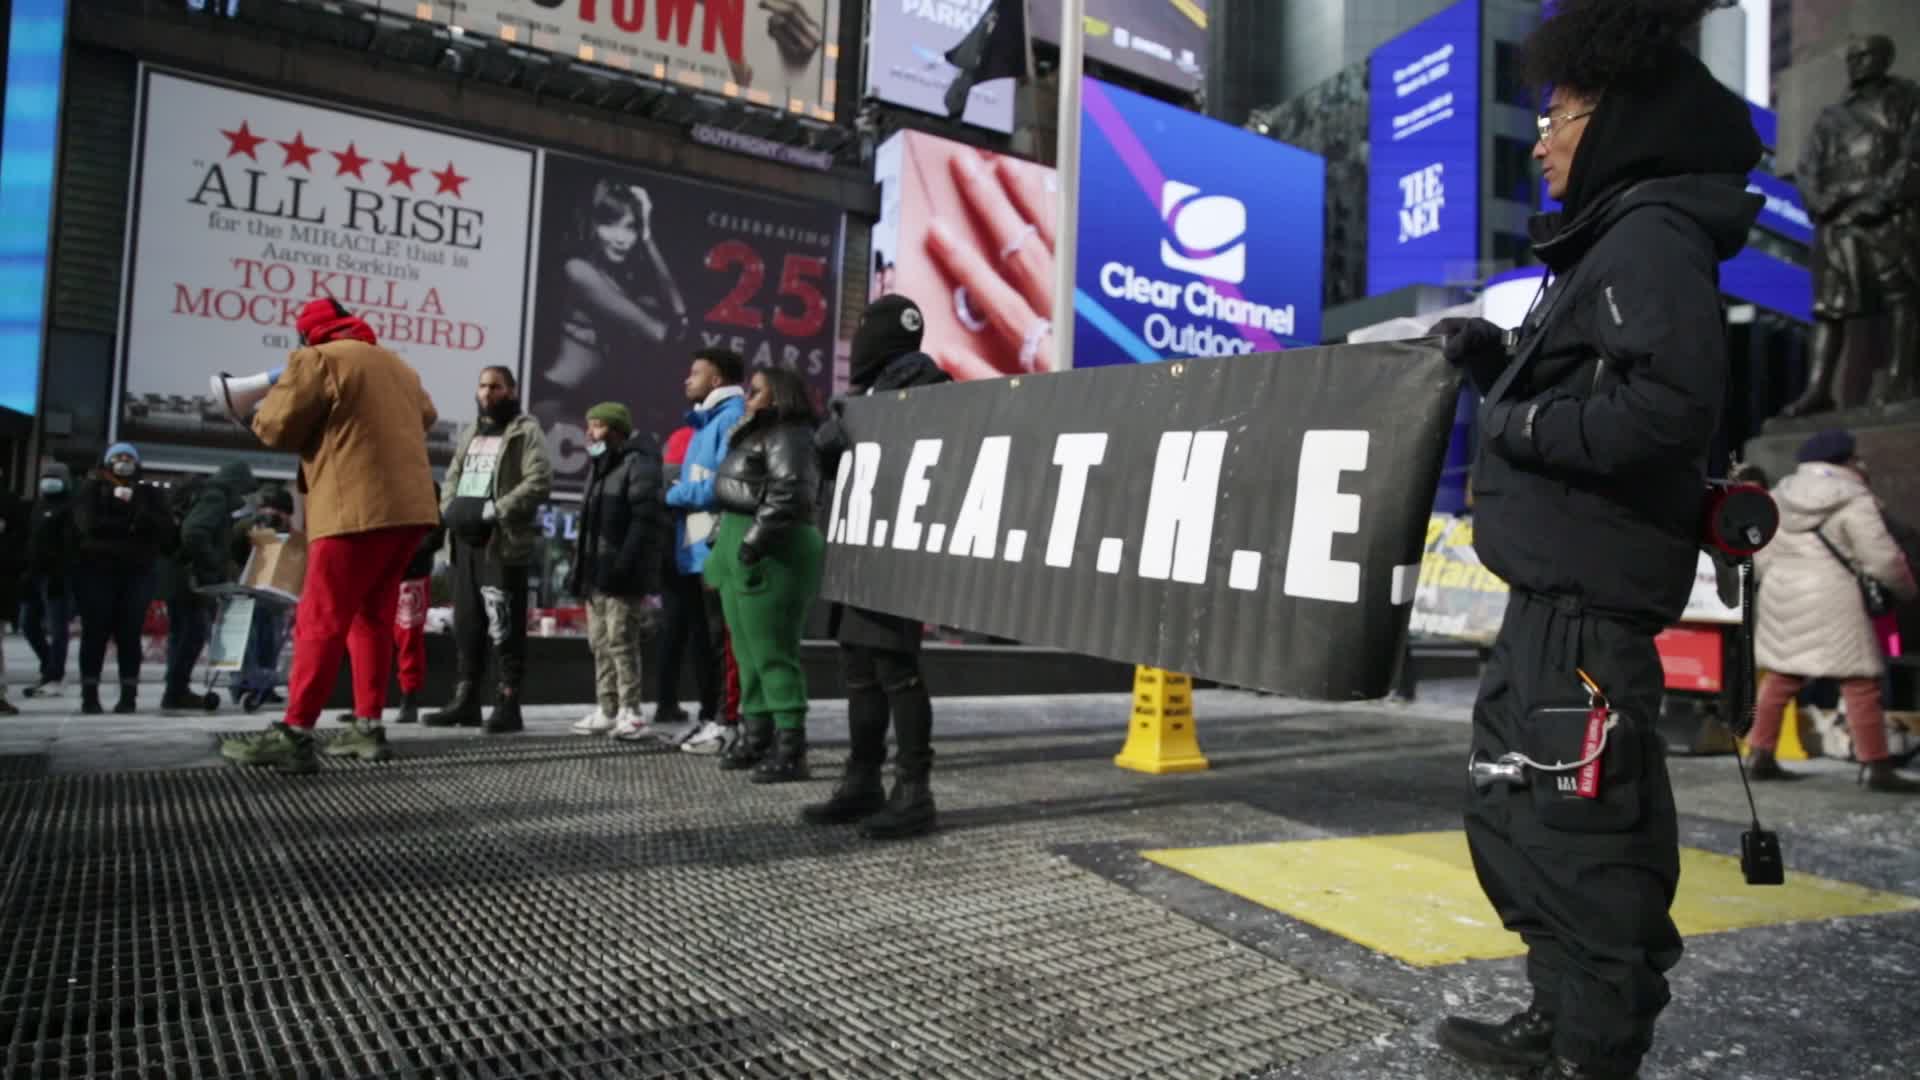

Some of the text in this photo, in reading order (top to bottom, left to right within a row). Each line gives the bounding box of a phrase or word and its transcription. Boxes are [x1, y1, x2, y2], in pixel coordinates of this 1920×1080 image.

[207, 210, 470, 269] for the MIRACLE that is
[341, 185, 485, 251] RISE
[707, 211, 832, 248] CELEBRATING
[261, 242, 331, 268] Aaron
[231, 256, 447, 316] TO KILL A
[704, 239, 828, 337] 25
[1099, 261, 1296, 336] Clear Channel
[172, 282, 487, 352] MOCKGBIRD
[262, 333, 290, 350] on
[1144, 312, 1256, 358] Outdoor
[701, 331, 825, 376] YEARS
